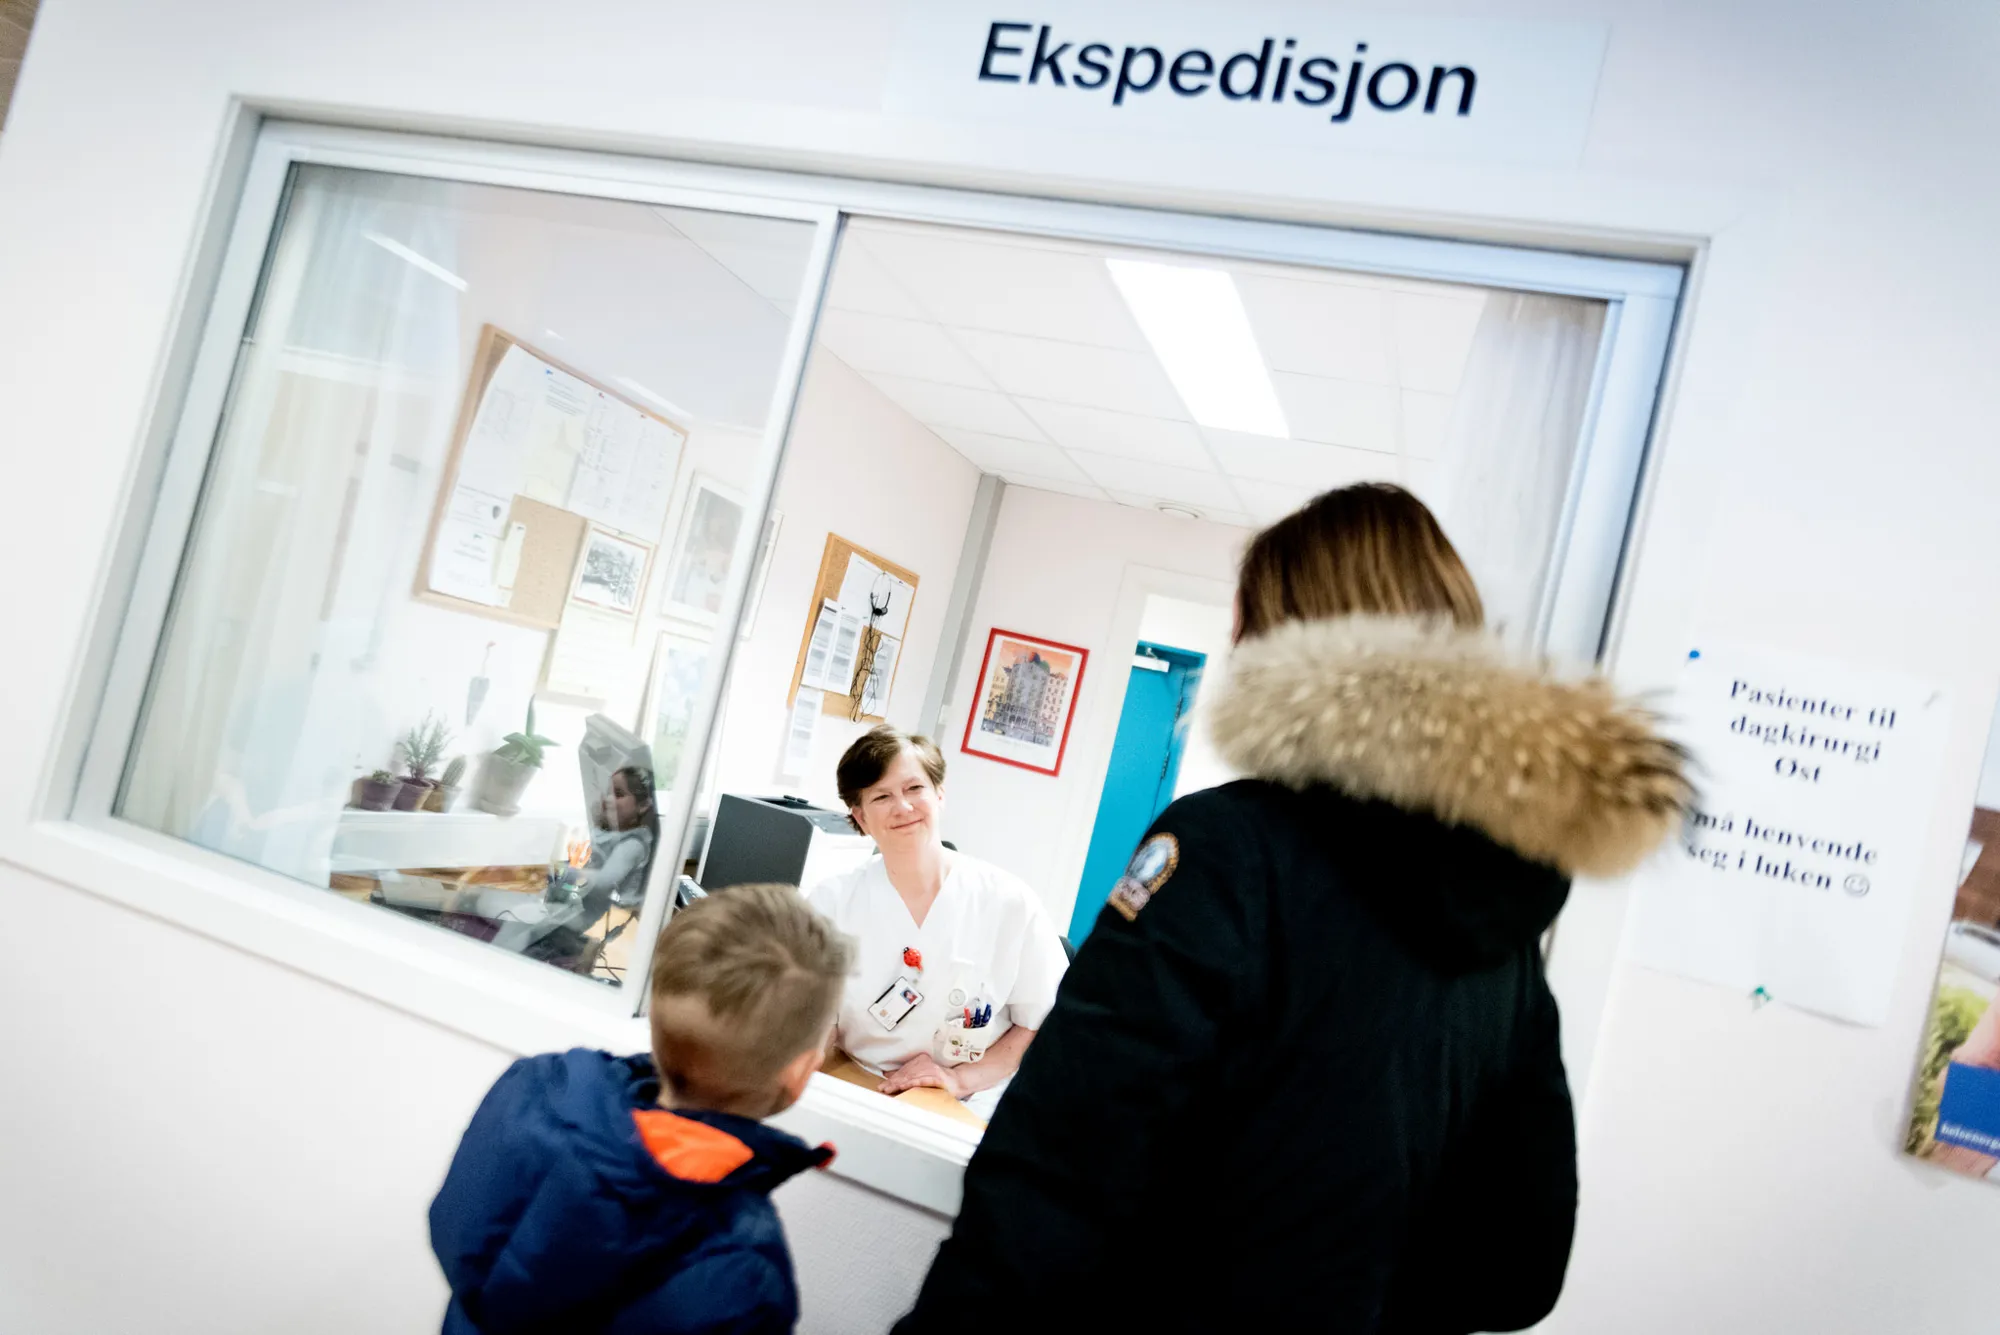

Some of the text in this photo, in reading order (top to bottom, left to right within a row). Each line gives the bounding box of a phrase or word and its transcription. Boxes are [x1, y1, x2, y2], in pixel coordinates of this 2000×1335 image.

[979, 21, 1478, 123] Ekspedisjon
[1731, 679, 1896, 729] Pasienter til
[1730, 715, 1882, 763] dagkirurgi
[1745, 817, 1878, 865] henvende
[1687, 845, 1832, 890] seg i luken
